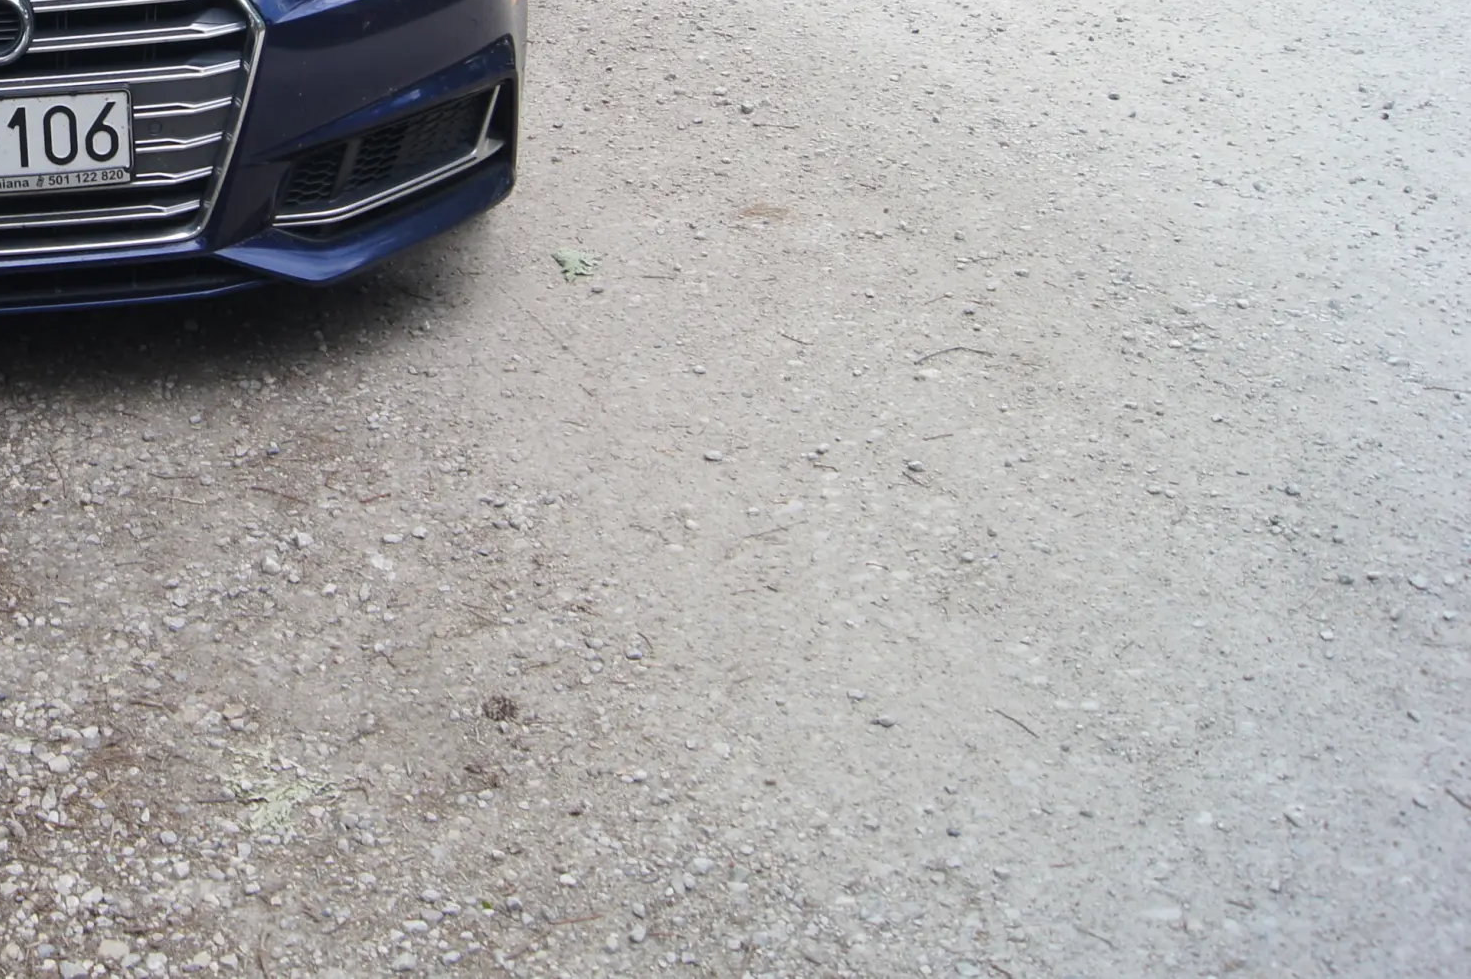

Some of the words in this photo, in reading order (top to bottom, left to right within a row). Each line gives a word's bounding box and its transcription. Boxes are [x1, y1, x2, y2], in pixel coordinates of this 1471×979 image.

[48, 175, 70, 186] 501
[75, 172, 98, 183] 122
[101, 169, 125, 181] 820
